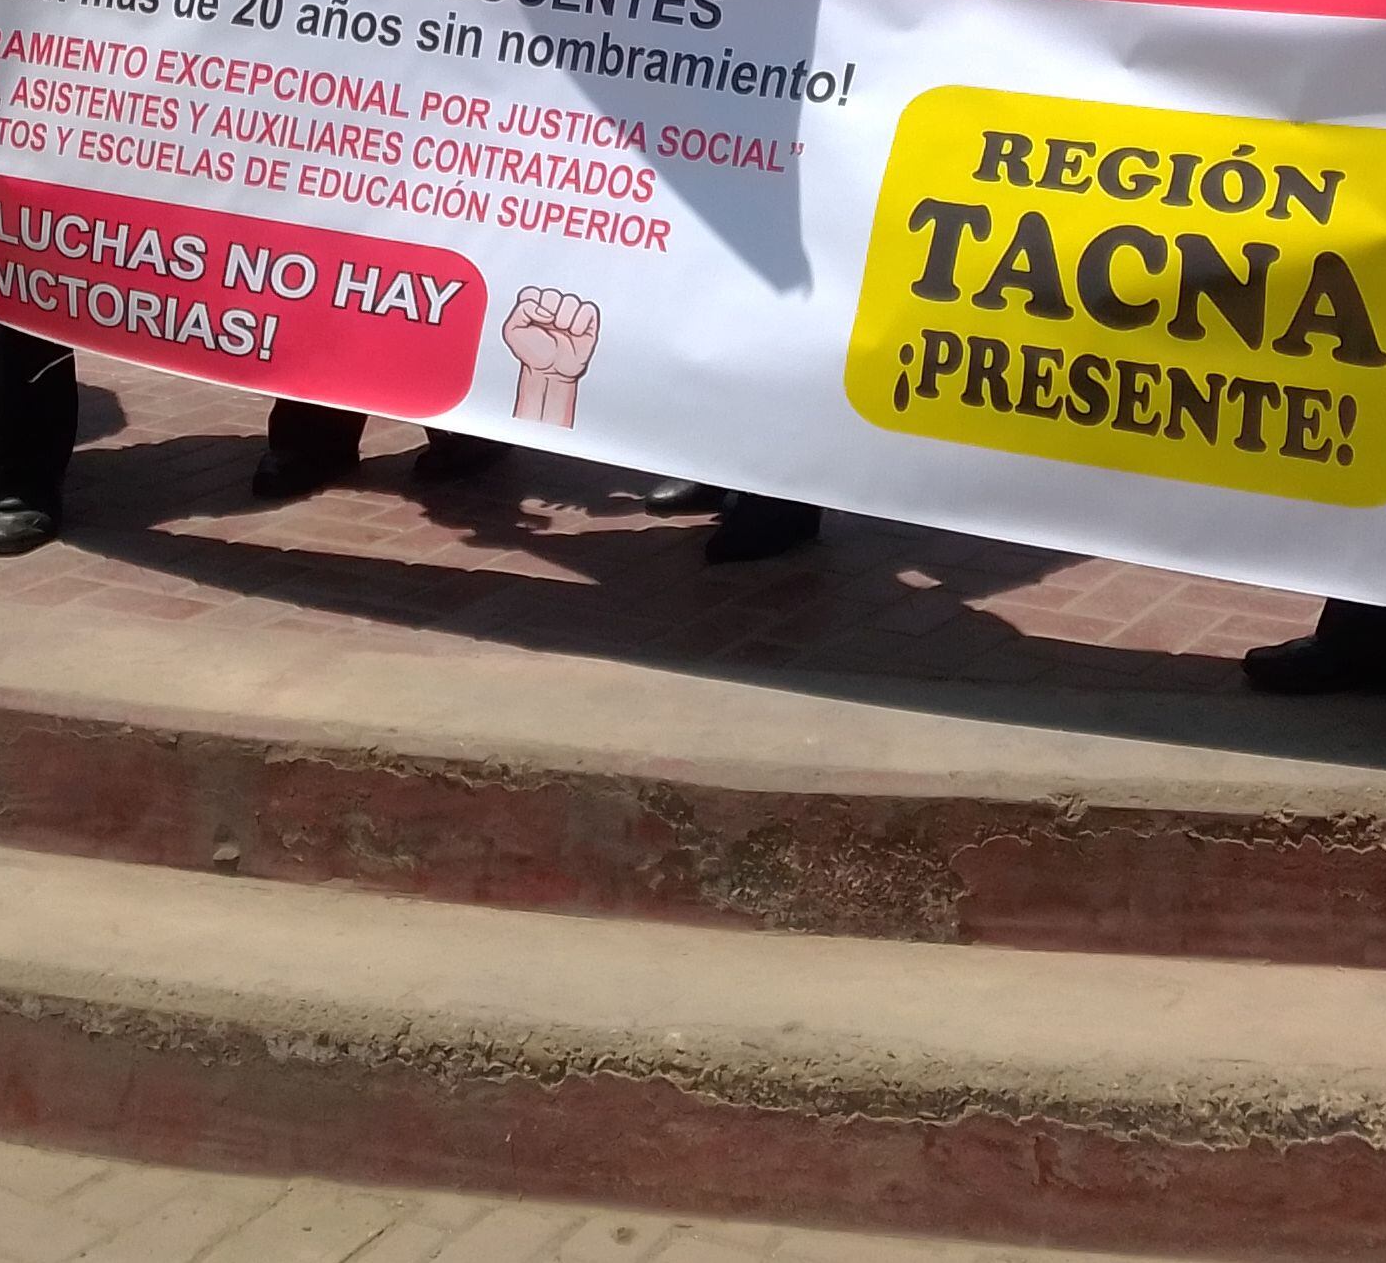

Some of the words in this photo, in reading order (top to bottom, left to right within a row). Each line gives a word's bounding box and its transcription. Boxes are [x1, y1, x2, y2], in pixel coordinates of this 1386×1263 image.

[154, 48, 411, 120] EXCEPCIONAL
[418, 89, 493, 132] POR
[496, 103, 649, 155] JUSTICIA
[655, 124, 806, 176] SOCIAL”
[414, 8, 483, 60] sin
[496, 30, 857, 108] nombramiento!
[8, 77, 180, 131] ASISTENTES
[189, 101, 212, 134] Y
[208, 104, 405, 168] AUXILIARES
[410, 136, 659, 207] CONTRATADOS
[55, 125, 75, 155] Y
[76, 133, 236, 184] ESCUELAS
[242, 158, 293, 193] DE
[296, 162, 491, 224] EDUCACIÓN
[496, 196, 672, 254] SUPERIOR
[971, 129, 1347, 226] REGIÓN
[222, 243, 319, 302] NO
[332, 260, 471, 328] HAY
[891, 327, 1359, 468] ¡PRESENTE!
